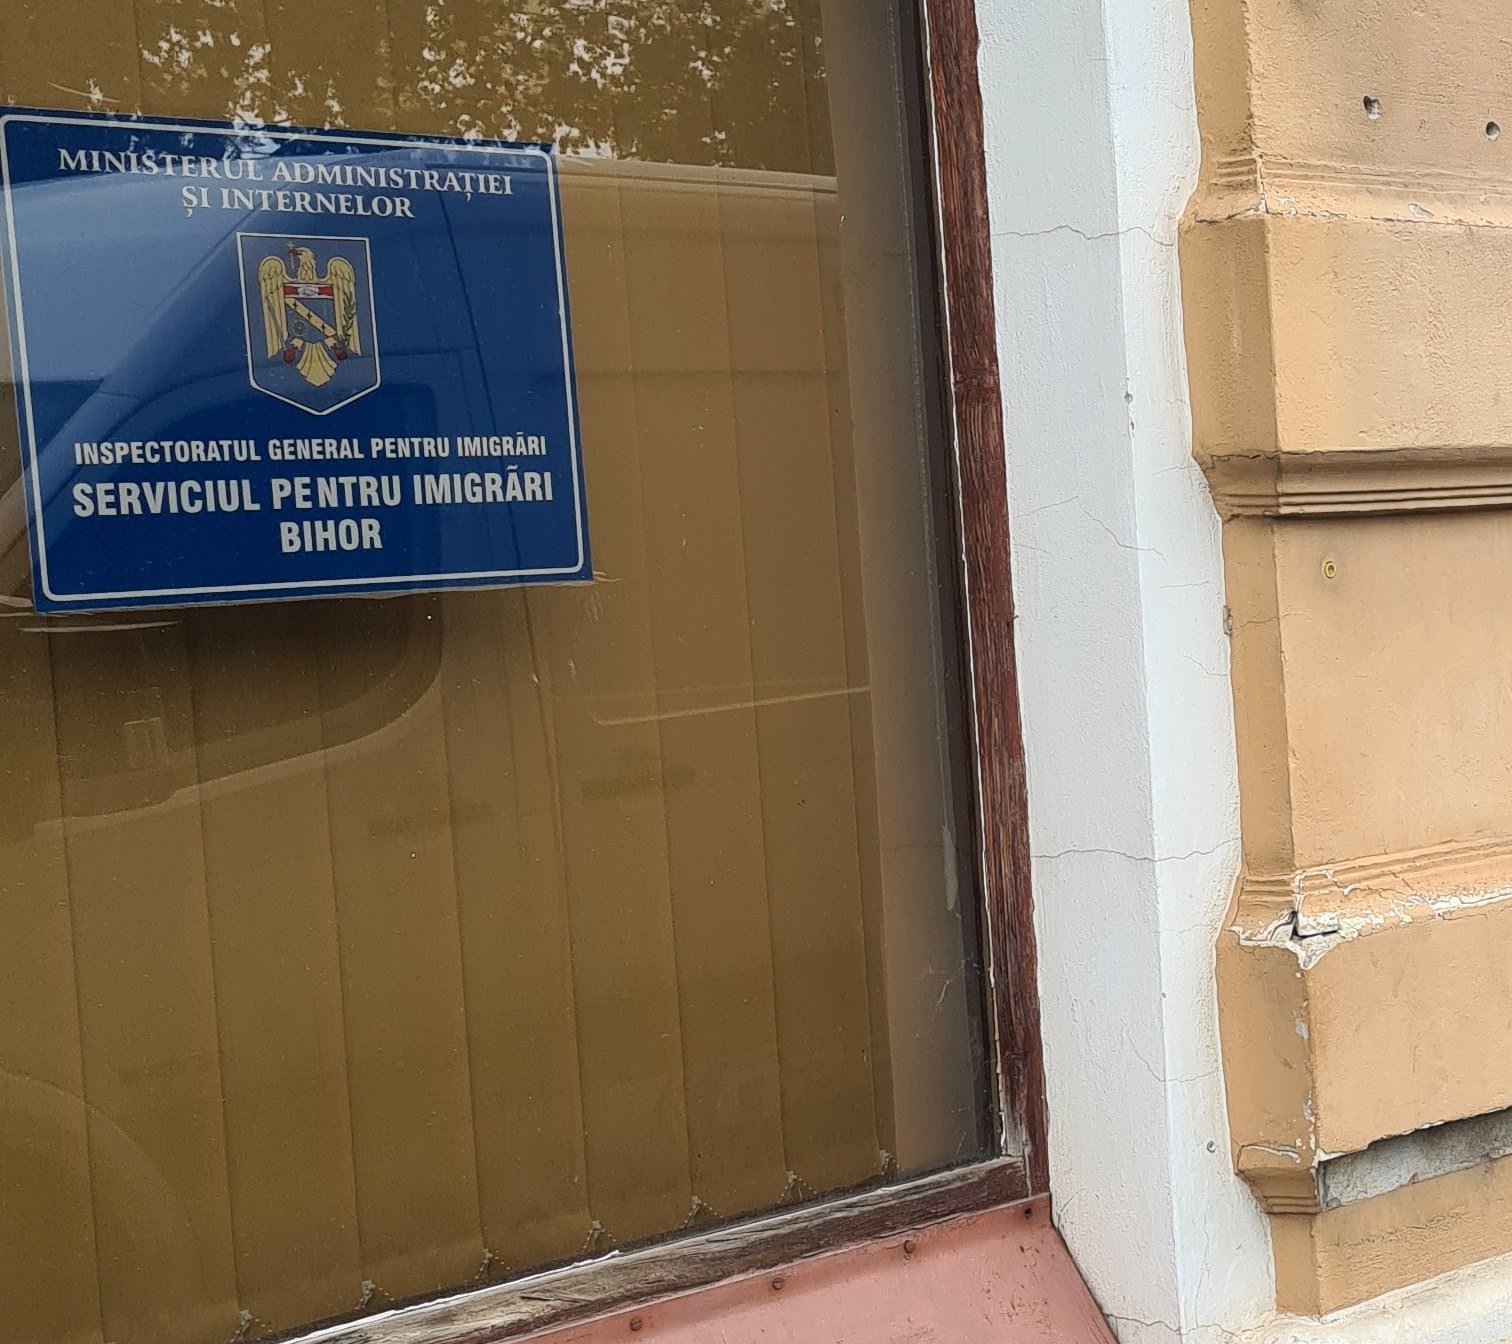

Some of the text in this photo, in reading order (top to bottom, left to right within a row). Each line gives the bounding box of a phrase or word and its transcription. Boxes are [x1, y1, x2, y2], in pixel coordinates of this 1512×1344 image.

[58, 148, 264, 181] MINISTERUL
[220, 187, 415, 218] INTERNELOR
[75, 438, 261, 465] INSPECTORATUL
[268, 437, 364, 462] GENERAL
[371, 436, 450, 459] PENTRU
[72, 477, 260, 518] SERVICIUL
[272, 474, 402, 510] PENTRU
[281, 518, 383, 553] BIHOR
